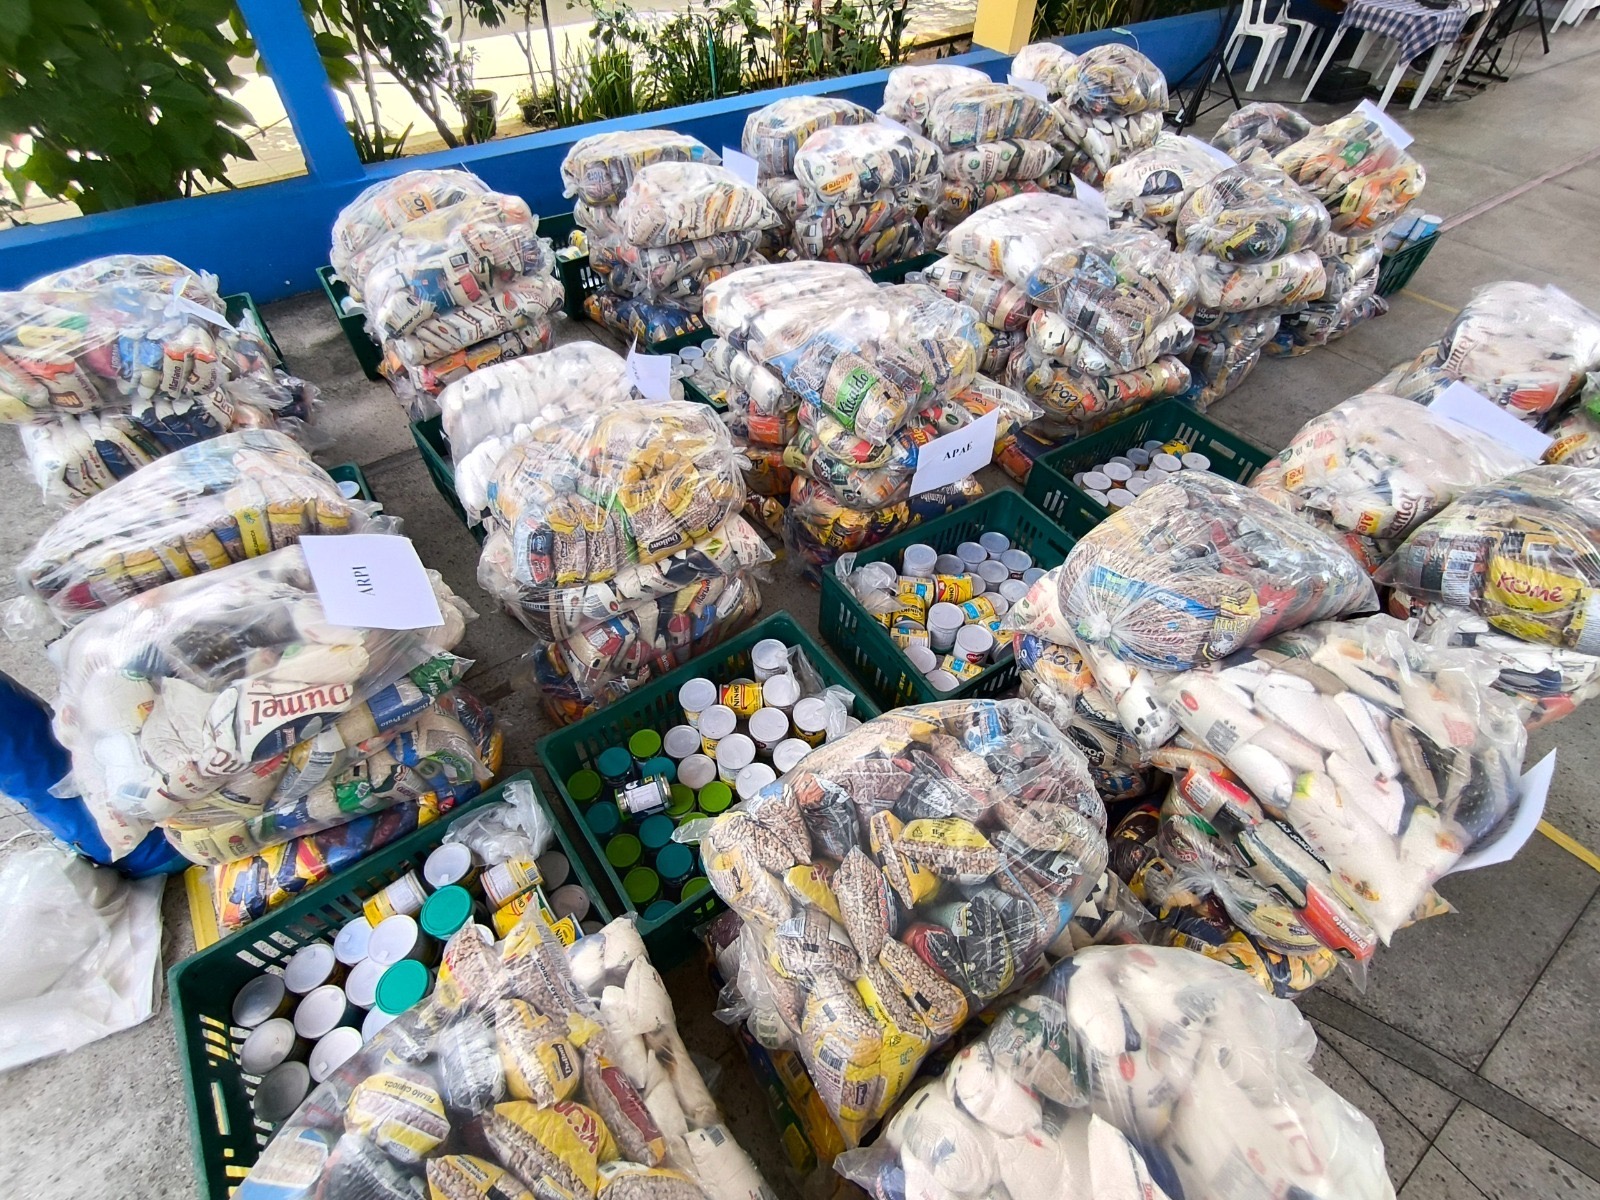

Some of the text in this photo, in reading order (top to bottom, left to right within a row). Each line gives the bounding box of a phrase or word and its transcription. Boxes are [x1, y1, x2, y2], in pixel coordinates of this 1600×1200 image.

[838, 372, 869, 417] Kicaldo
[1051, 382, 1079, 403] Pop
[943, 440, 973, 461] APAE
[352, 566, 376, 596] ARPI
[251, 683, 349, 727] Dumel
[732, 685, 741, 710] NINHO
[1332, 914, 1369, 950] Brilhante
[384, 1080, 436, 1104] FEIJÃO CARIOCA
